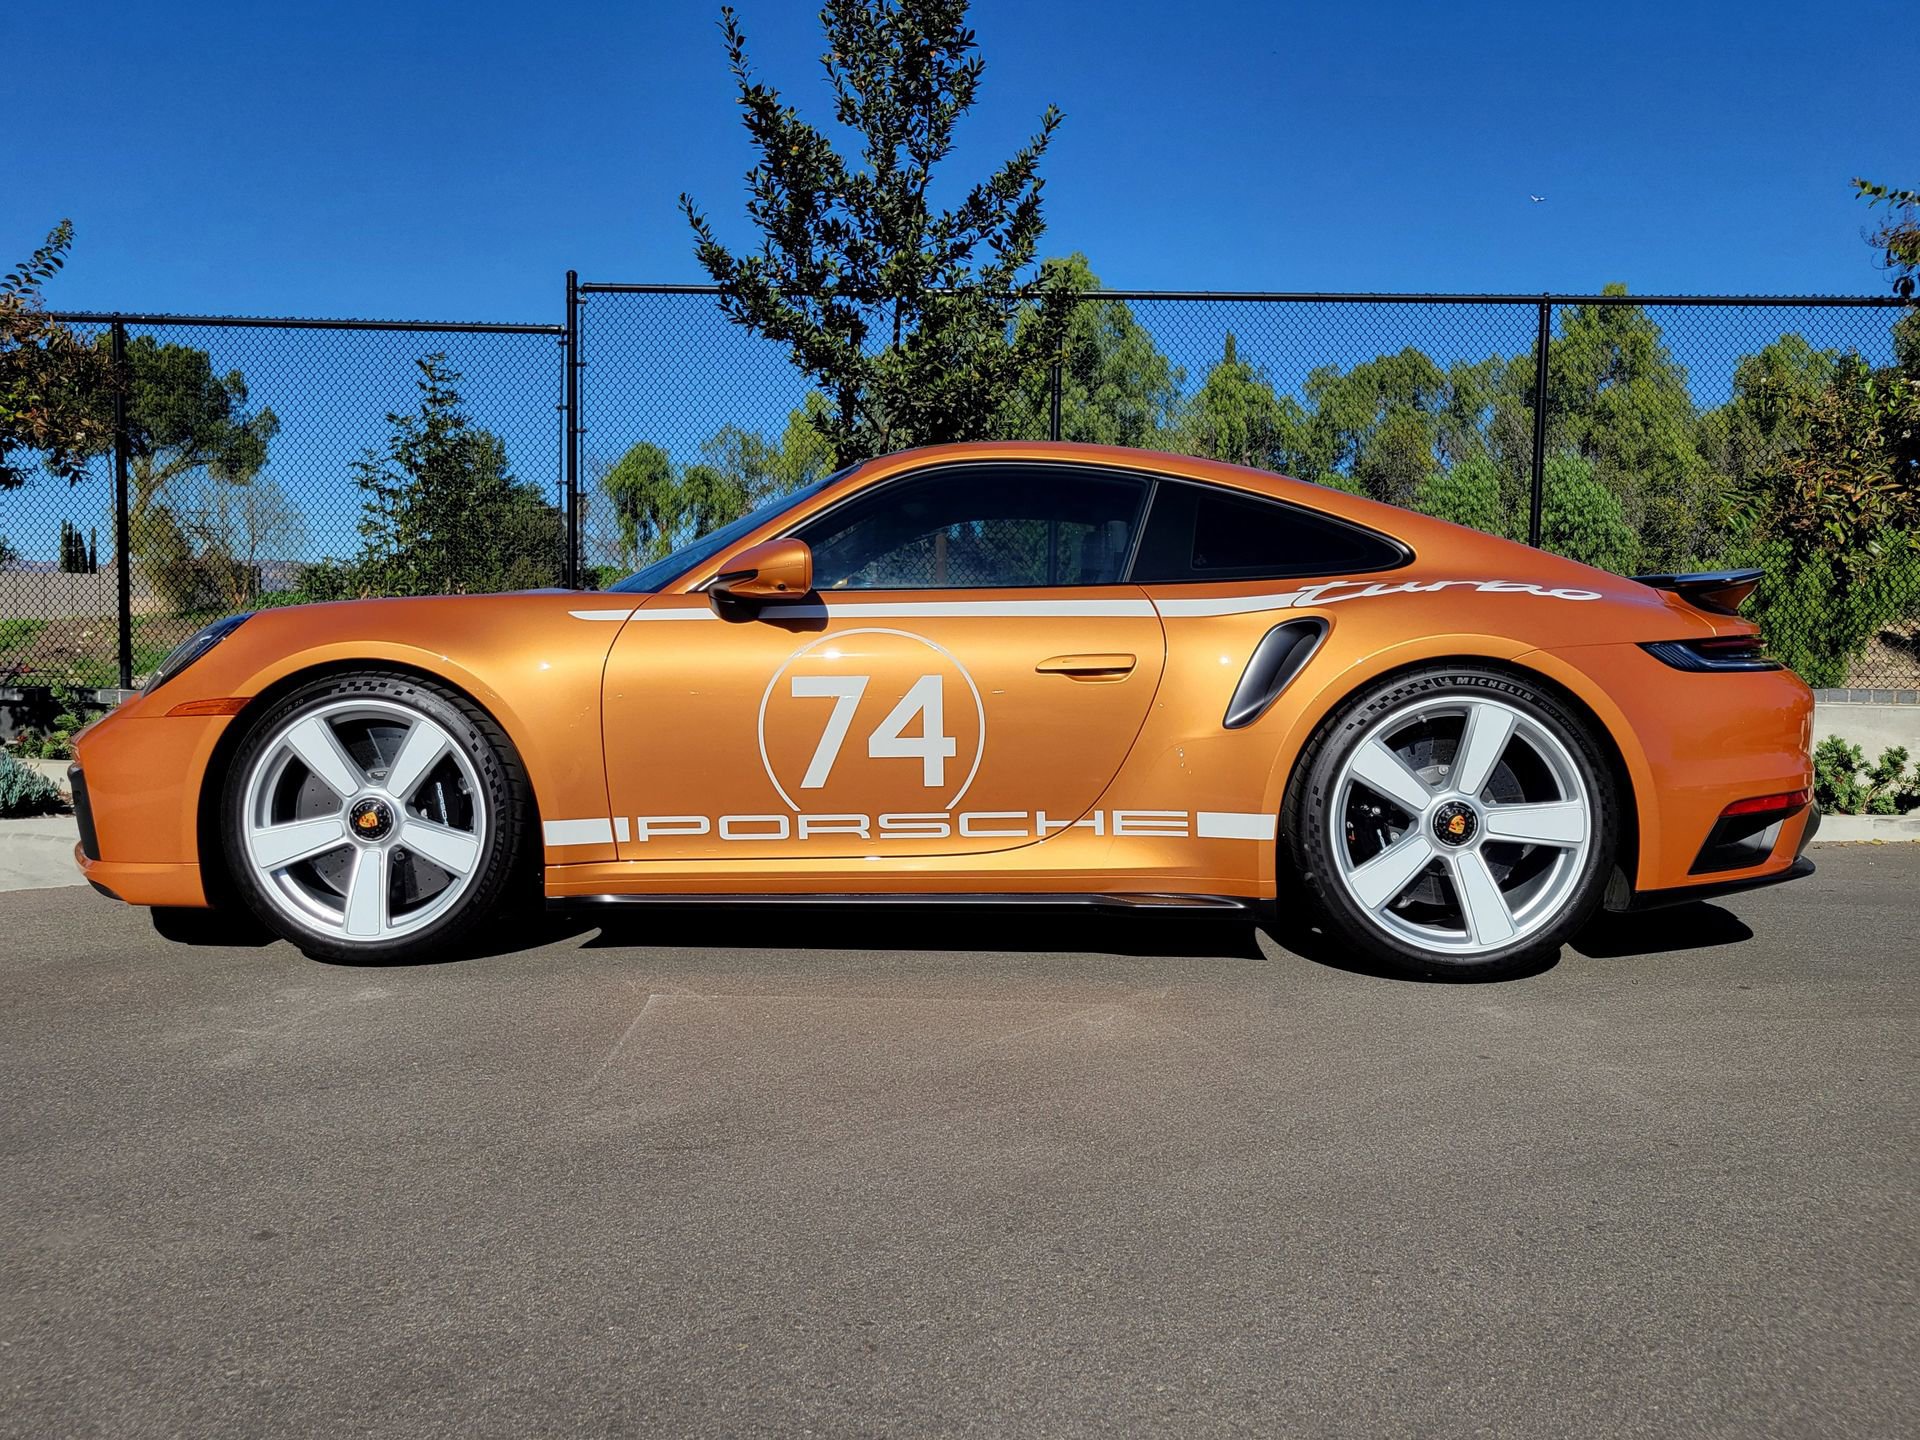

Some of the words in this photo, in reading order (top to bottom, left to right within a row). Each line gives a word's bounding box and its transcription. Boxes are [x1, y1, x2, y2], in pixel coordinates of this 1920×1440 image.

[1292, 580, 1603, 607] turbo
[1456, 676, 1535, 702] MICHELIN
[791, 674, 957, 789] 74
[1538, 701, 1561, 718] PILOT
[1558, 716, 1581, 739] SPORT
[435, 781, 449, 828] PORSCH
[636, 810, 1190, 842] PORSCHE
[473, 830, 506, 905] MICHELIN
